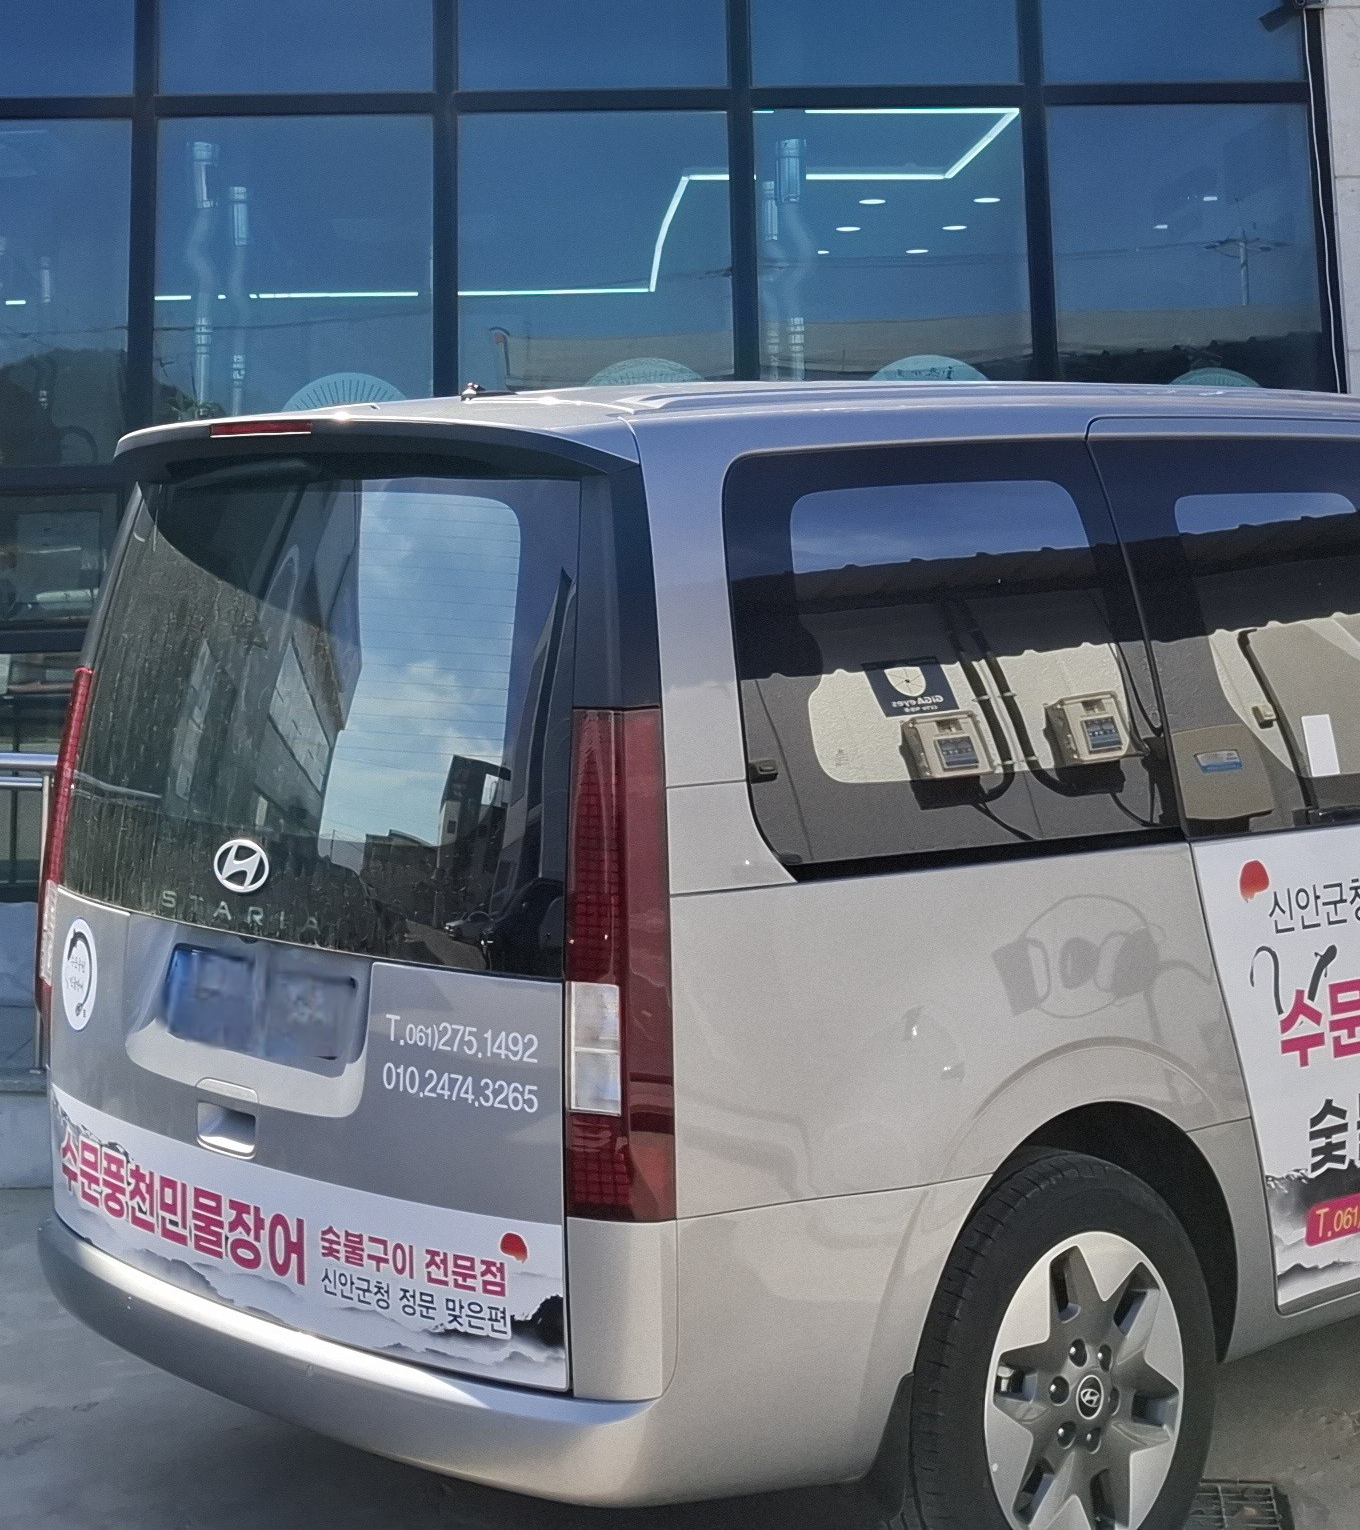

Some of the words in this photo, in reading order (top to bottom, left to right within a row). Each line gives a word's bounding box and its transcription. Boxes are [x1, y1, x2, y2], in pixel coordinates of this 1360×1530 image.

[383, 1062, 539, 1113] 010.2474.3265
[60, 1131, 308, 1285] 수문풍천민물장어
[320, 1224, 417, 1280] 숯불구이
[424, 1246, 508, 1298] 전문점
[320, 1267, 392, 1310] 신안군청
[398, 1284, 438, 1321] 정문
[444, 1296, 508, 1336] 맞은편
